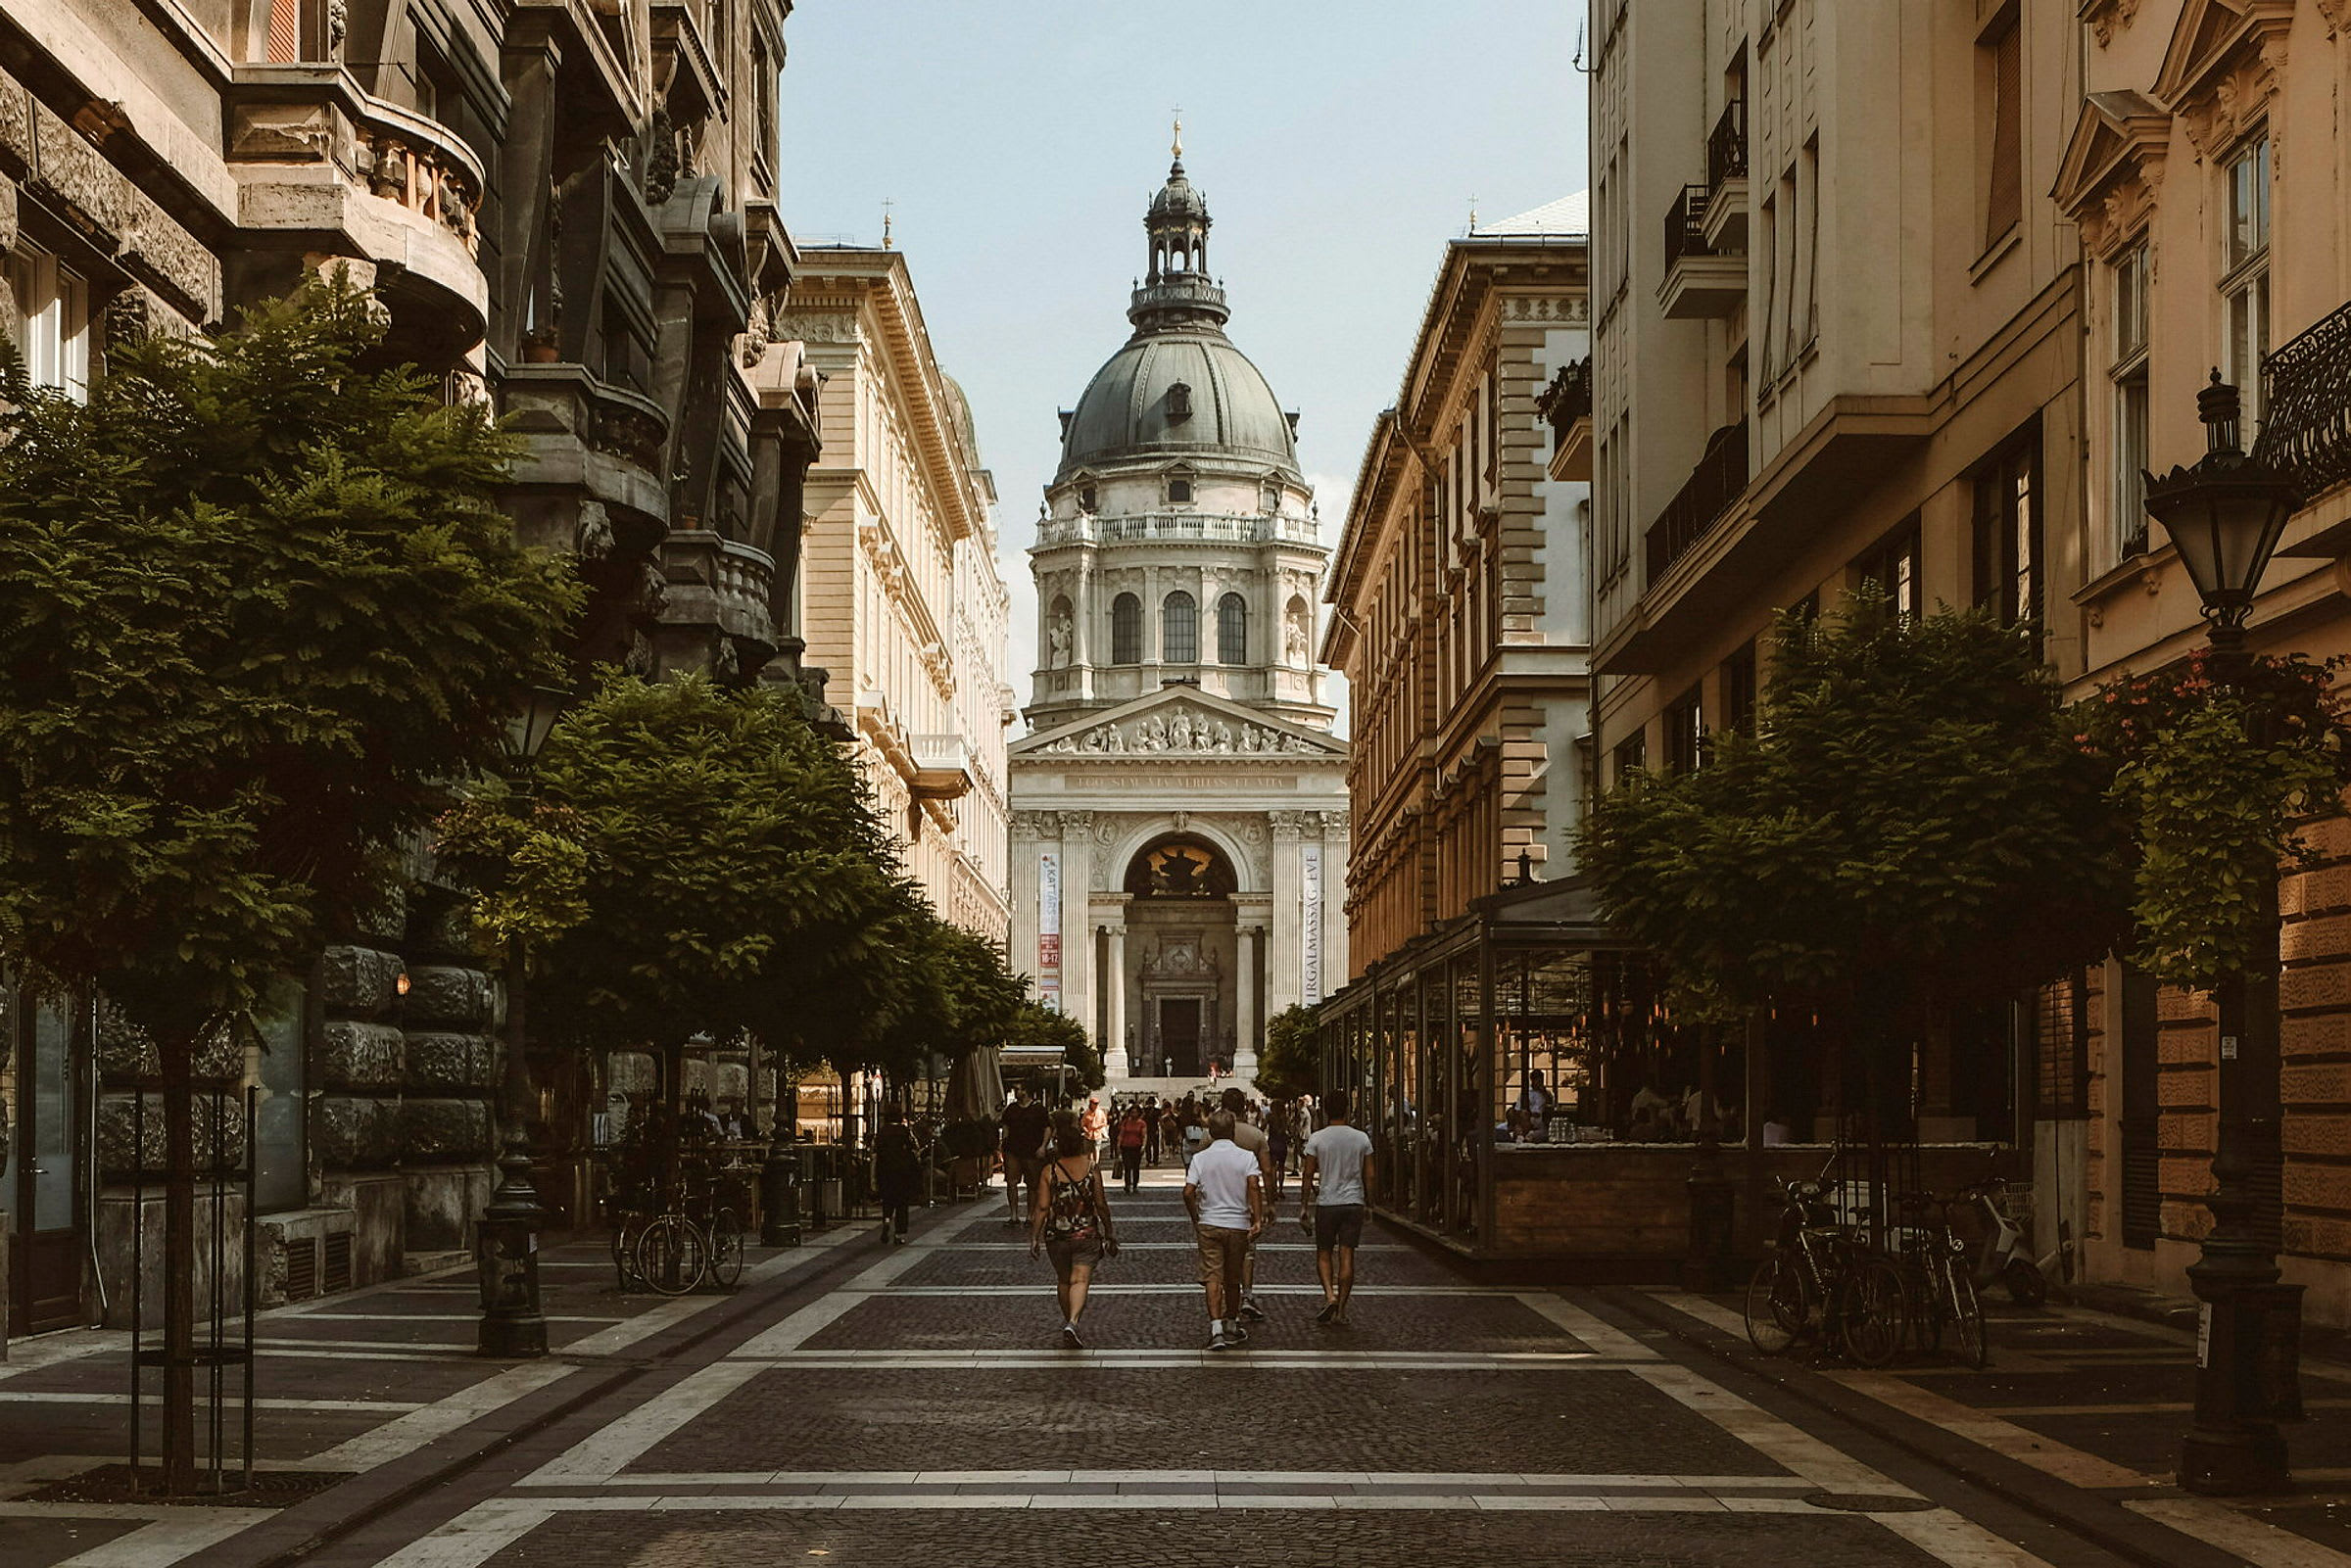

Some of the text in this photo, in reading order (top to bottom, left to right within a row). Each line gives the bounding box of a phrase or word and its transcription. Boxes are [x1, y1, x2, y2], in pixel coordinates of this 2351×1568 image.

[1079, 777, 1104, 787] EGO
[1112, 777, 1139, 787] SUM
[1148, 777, 1170, 787] VIA
[1235, 777, 1249, 787] ET
[1257, 777, 1283, 787] VITA
